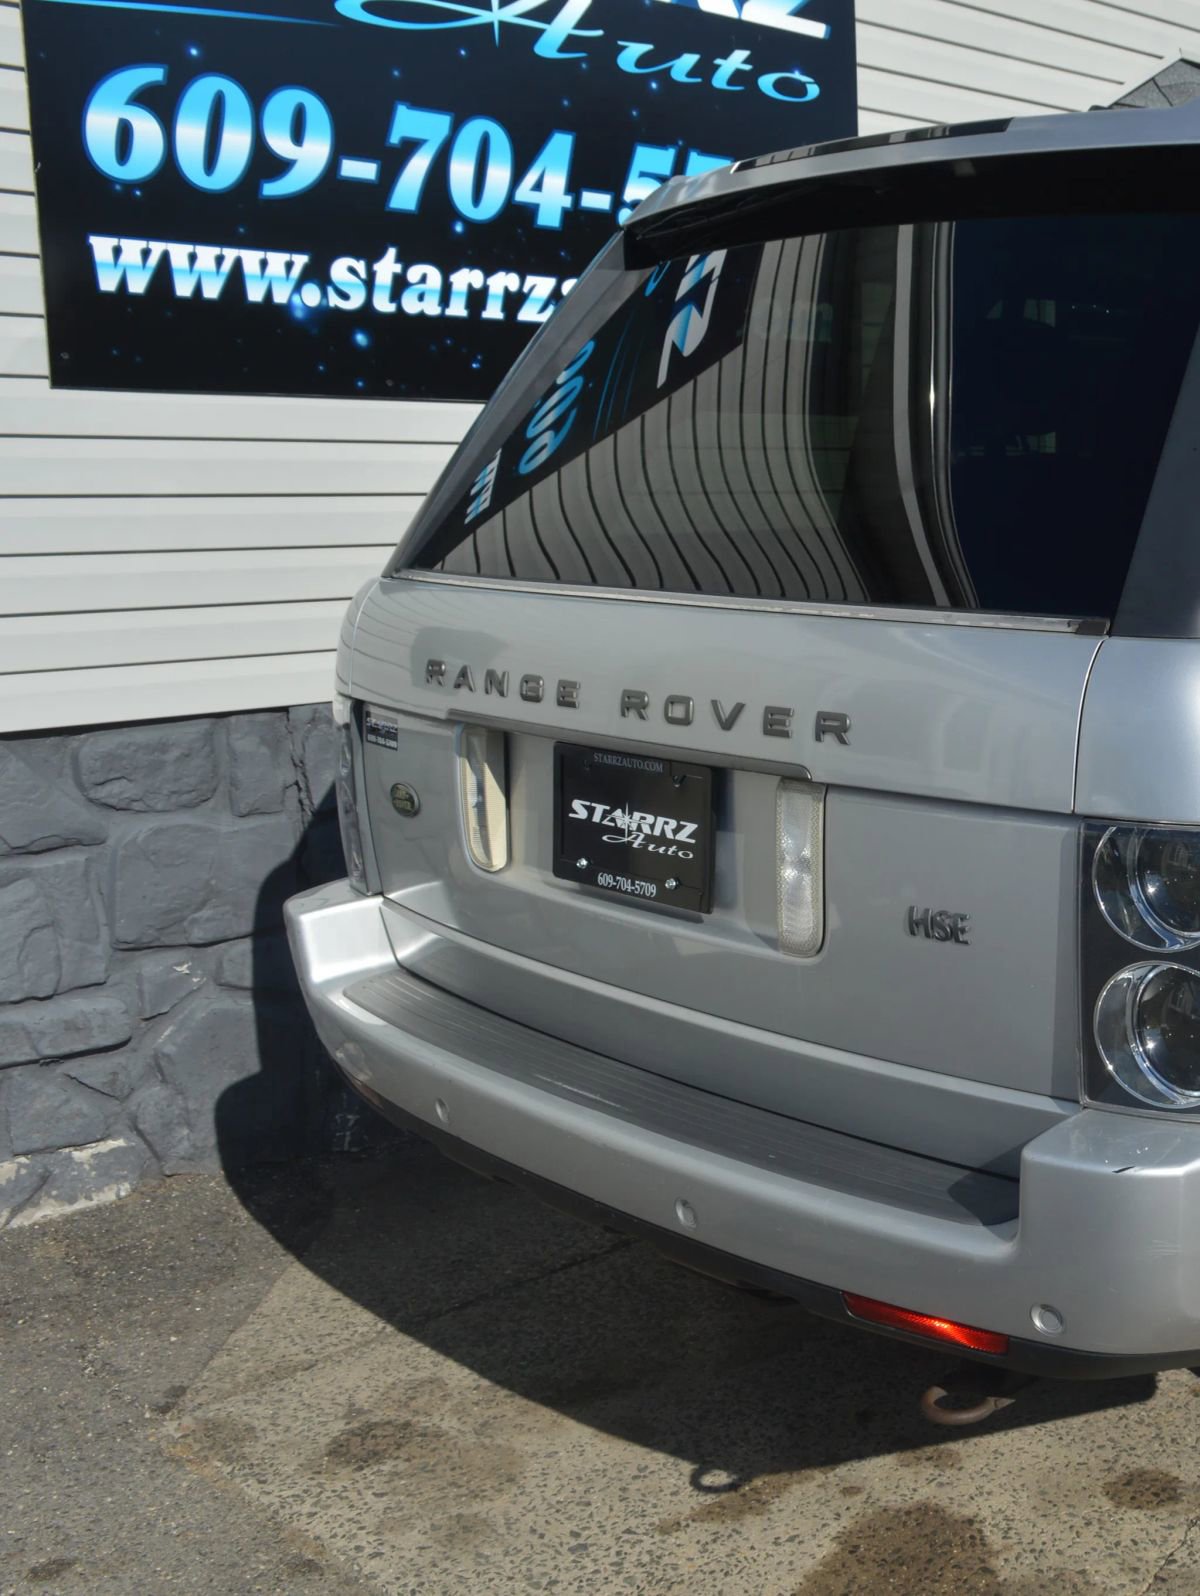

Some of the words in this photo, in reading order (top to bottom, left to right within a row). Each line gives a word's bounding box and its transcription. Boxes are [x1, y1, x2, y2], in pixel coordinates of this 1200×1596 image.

[87, 233, 578, 323] www.starrz
[425, 658, 581, 709] RANGE
[620, 688, 852, 746] ROVER
[594, 752, 664, 773] STARRZAUTO.COM
[568, 798, 699, 844] STARRZ
[601, 831, 694, 859] Auto
[597, 872, 657, 897] 609-704-5709
[908, 904, 971, 946] HSE
